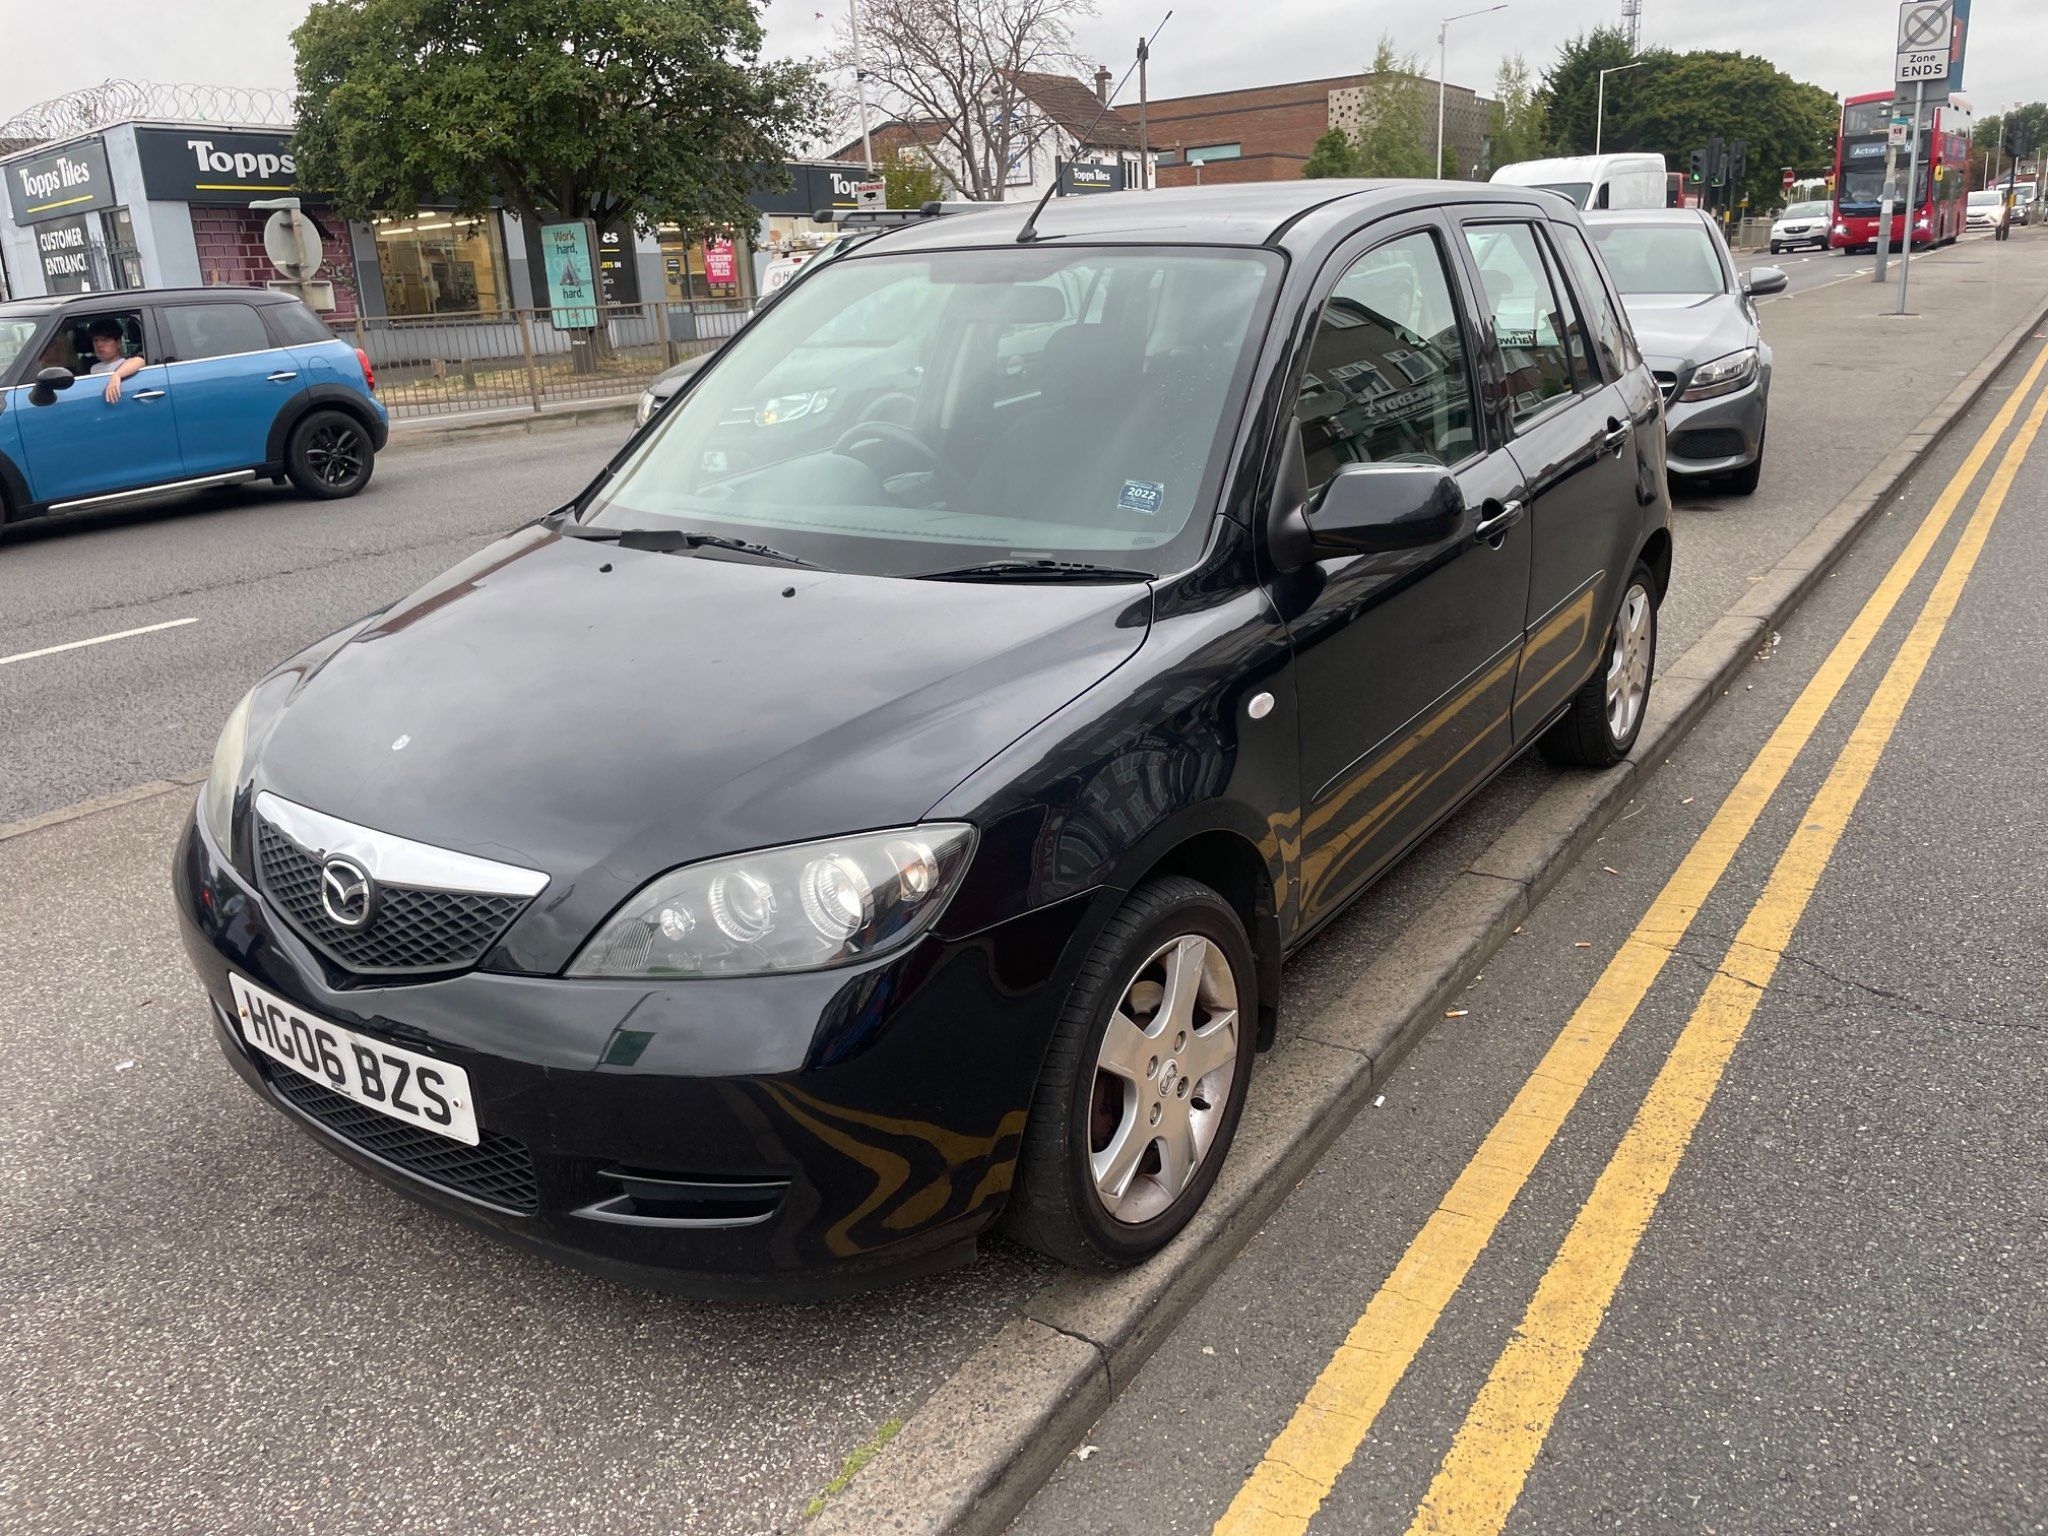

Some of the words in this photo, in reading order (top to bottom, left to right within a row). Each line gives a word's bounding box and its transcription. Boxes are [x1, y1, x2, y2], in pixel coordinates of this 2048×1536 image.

[1910, 54, 1936, 63] Zone
[1901, 64, 1943, 77] ENDS
[1854, 146, 1879, 156] Acton
[187, 140, 298, 179] Topps
[18, 168, 60, 199] Topps
[57, 157, 90, 187] Tiles
[1072, 167, 1095, 182] Topps
[1094, 168, 1111, 181] Tiles
[830, 173, 867, 198] Top
[40, 227, 84, 251] CUSTOMER
[552, 230, 576, 242] Work
[556, 243, 578, 255] hard,
[562, 288, 584, 299] hard.
[1127, 487, 1157, 500] 2022
[245, 991, 346, 1085] HG06
[350, 1042, 452, 1126] BZS
